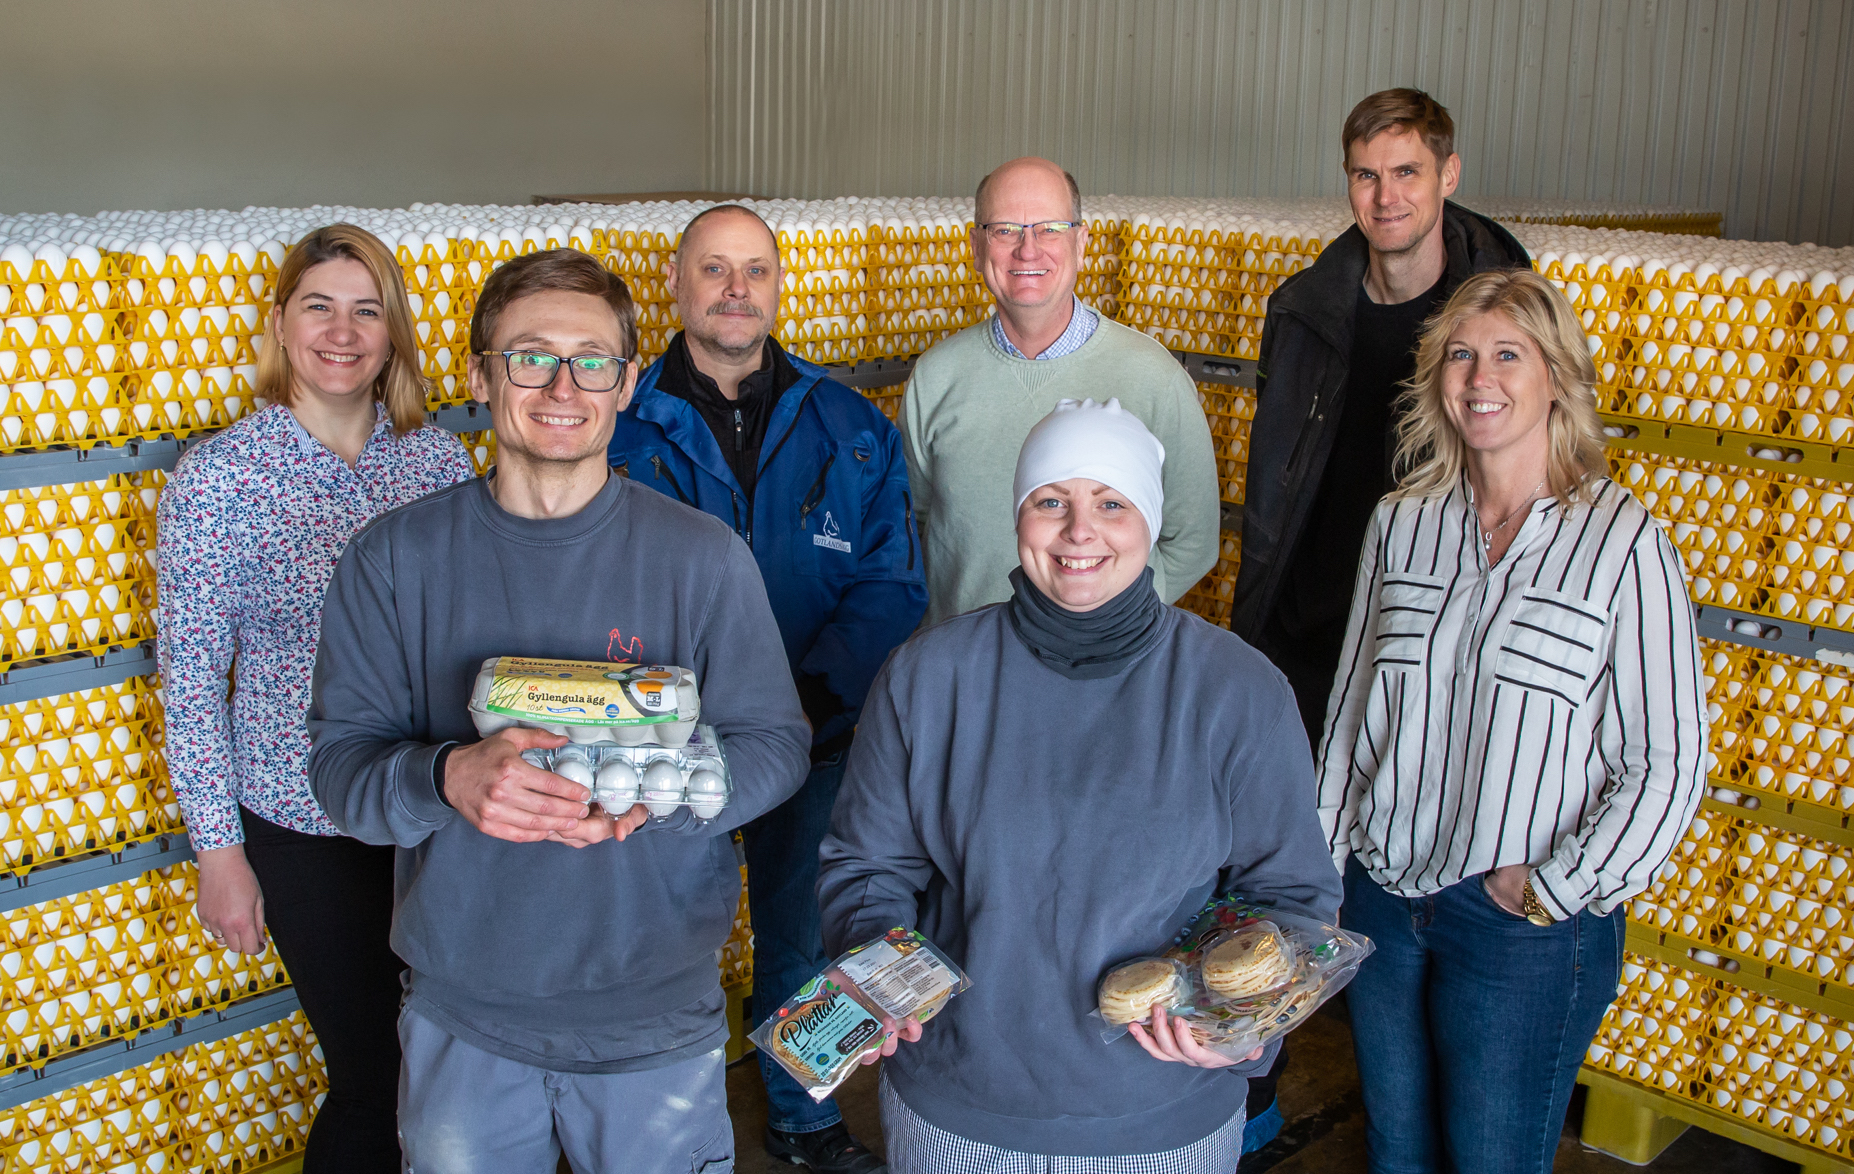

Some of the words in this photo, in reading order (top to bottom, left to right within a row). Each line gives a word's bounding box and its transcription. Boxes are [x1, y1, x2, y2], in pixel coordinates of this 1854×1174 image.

[527, 692, 585, 705] Gyllengula
[586, 695, 605, 706] ägg
[780, 993, 838, 1047] Plättar
